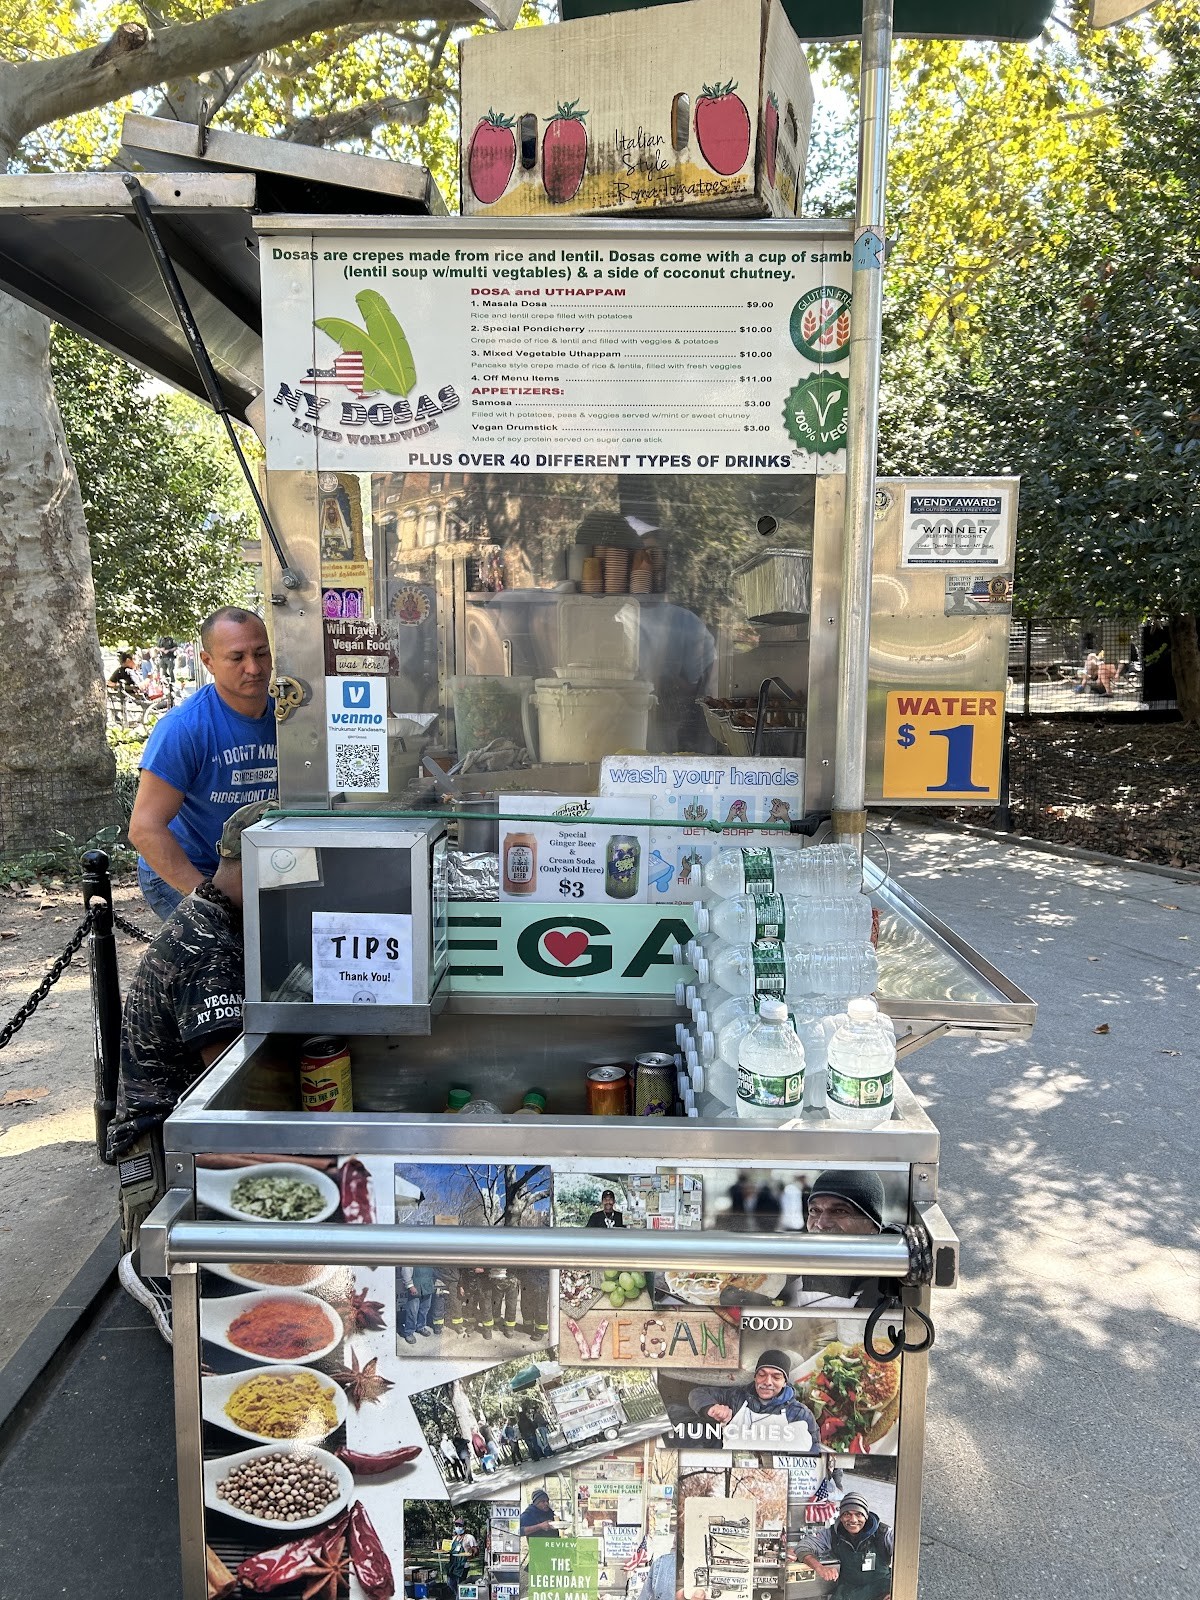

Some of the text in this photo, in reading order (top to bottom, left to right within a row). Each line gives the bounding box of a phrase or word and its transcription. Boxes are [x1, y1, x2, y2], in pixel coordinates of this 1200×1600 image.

[615, 126, 665, 151] Italian
[623, 150, 670, 181] Style
[613, 182, 659, 203] Roma
[657, 174, 728, 197] Tomatoes
[272, 248, 319, 262] Dosas
[323, 251, 348, 261] are
[352, 251, 405, 264] crepes
[409, 249, 451, 262] made
[454, 249, 490, 262] from
[494, 249, 524, 262] rice
[528, 249, 556, 262] and
[561, 249, 604, 262] lentil.
[609, 249, 656, 263] Dosas
[659, 252, 702, 263] come
[706, 250, 740, 263] with
[744, 253, 754, 263] a
[758, 253, 787, 266] cup
[791, 250, 807, 263] of
[343, 265, 796, 282] (lentil soup w/multi vegtables) & a side of coconut chutney.
[470, 287, 626, 297] DOSA and UTHAPPAM
[746, 301, 774, 309] $9.00
[798, 288, 853, 312] GLUTEN FRE
[556, 312, 576, 320] filled
[597, 313, 633, 321] potatoes
[482, 325, 520, 334] Special
[523, 325, 586, 334] Pondicherry
[739, 326, 773, 334] $10.00
[470, 349, 621, 359] 3. Mixed Vegetable Uthappam
[482, 374, 499, 382] Off
[501, 374, 529, 382] Menu
[739, 375, 773, 383] $11.00
[471, 387, 565, 396] APPETIZERS:
[273, 382, 460, 427] NY DOSAS
[744, 400, 771, 408] $3.00
[291, 417, 440, 446] LOVED WORLDWIDE
[471, 423, 504, 432] Vegan
[743, 424, 770, 432] $3.00
[794, 409, 817, 442] 100%
[507, 436, 522, 444] soy
[643, 436, 663, 444] stick
[408, 452, 792, 469] PLUS OVER 40 DIFFERENT TYPES OF DRINKS
[915, 498, 997, 507] VENDY AWARD
[923, 526, 988, 534] WINNER
[908, 518, 1000, 556] 2007
[326, 622, 346, 635] Will
[349, 623, 378, 636] Travel
[332, 638, 391, 652] Vegan Food
[338, 658, 386, 670] was here!
[897, 697, 997, 716] WATER
[331, 712, 383, 725] venmo
[234, 769, 274, 782] SINCE 1982
[609, 765, 799, 788] wash your hands
[209, 789, 267, 804] RIDGEMONT
[558, 831, 587, 840] Special
[549, 839, 597, 848] Ginger Beer
[569, 848, 577, 856] &
[548, 856, 596, 865] Cream Soda
[511, 865, 529, 873] GINGER
[539, 865, 605, 874] (Only Sold Here)
[558, 876, 585, 898] $3
[330, 935, 400, 961] TIPS
[338, 971, 391, 983] Thank You!
[203, 993, 243, 1009] VEGAN
[197, 1010, 211, 1025] NY
[740, 1316, 794, 1331] FOOD
[567, 1318, 727, 1361] VEGAN
[668, 1421, 796, 1440] MUNCHIES
[792, 1457, 817, 1469] DOSAS
[618, 1526, 638, 1536] DOSAS
[501, 1555, 519, 1563] CREPE
[551, 1558, 571, 1571] THE
[530, 1574, 591, 1588] LEGENDARY
[495, 1586, 520, 1596] PURE
[533, 1592, 589, 1600] DOSA MAN
